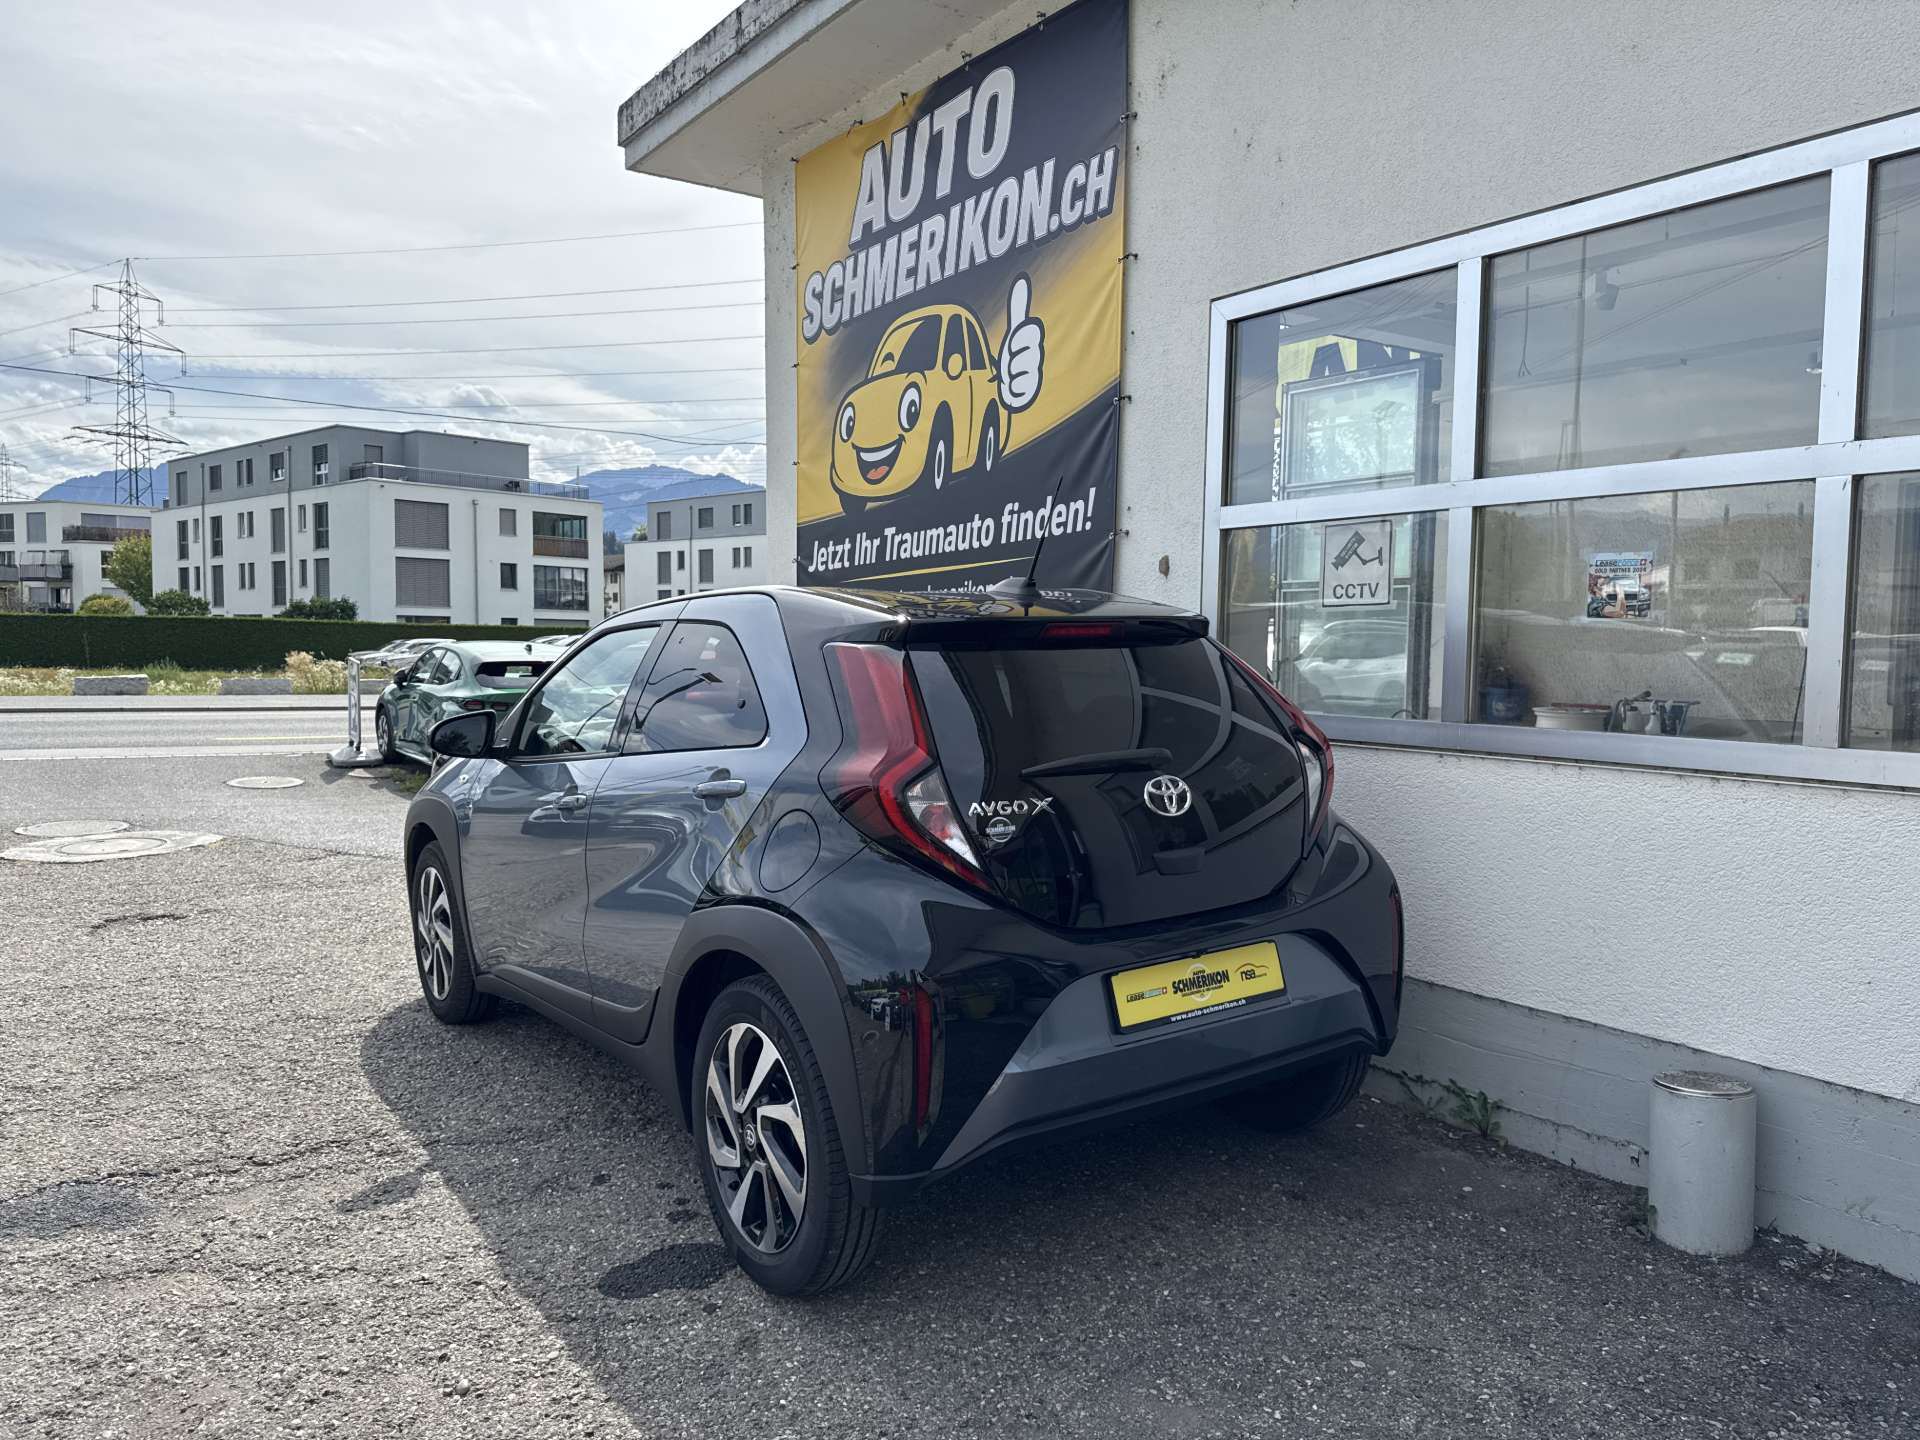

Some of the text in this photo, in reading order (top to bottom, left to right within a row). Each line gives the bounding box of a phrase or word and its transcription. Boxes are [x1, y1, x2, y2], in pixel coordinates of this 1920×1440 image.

[849, 66, 1015, 245] AUTO
[802, 147, 1118, 340] SCHMERIKON.CH
[807, 487, 1097, 573] Jetzt Ihr Traumauto finden!
[1333, 582, 1380, 600] CCTV
[968, 797, 1056, 817] AYGO X
[1172, 970, 1230, 994] SCHMERIKON
[1170, 999, 1246, 1021] www.auto-schmerikon.ch
